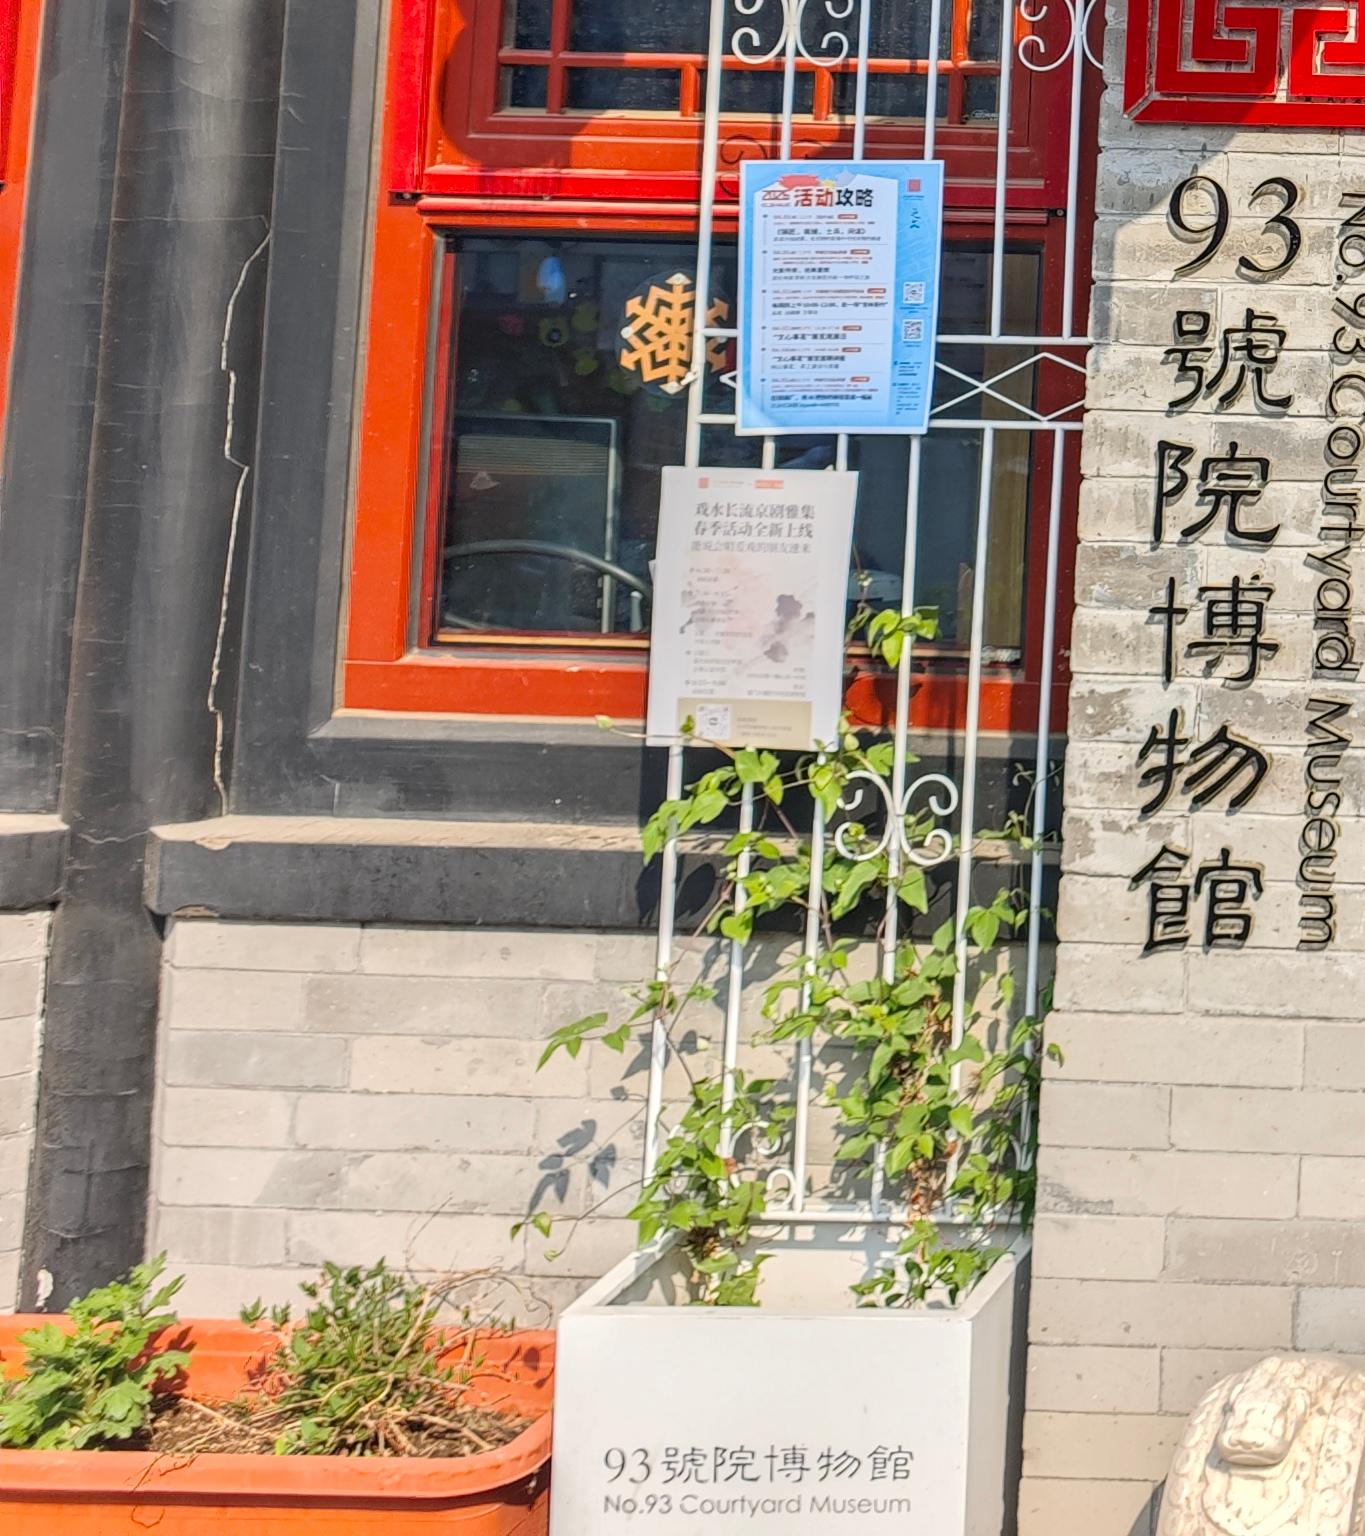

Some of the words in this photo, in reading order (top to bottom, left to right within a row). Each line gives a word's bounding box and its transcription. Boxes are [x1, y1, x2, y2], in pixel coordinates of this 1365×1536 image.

[794, 188, 873, 208] 活动攻略
[1128, 175, 1306, 955] 93號院博物館
[1297, 697, 1357, 954] Museum
[604, 1444, 915, 1485] 93號院博物館
[604, 1494, 672, 1515] No.93
[679, 1494, 801, 1515] Courtyard
[810, 1495, 912, 1514] Museum
